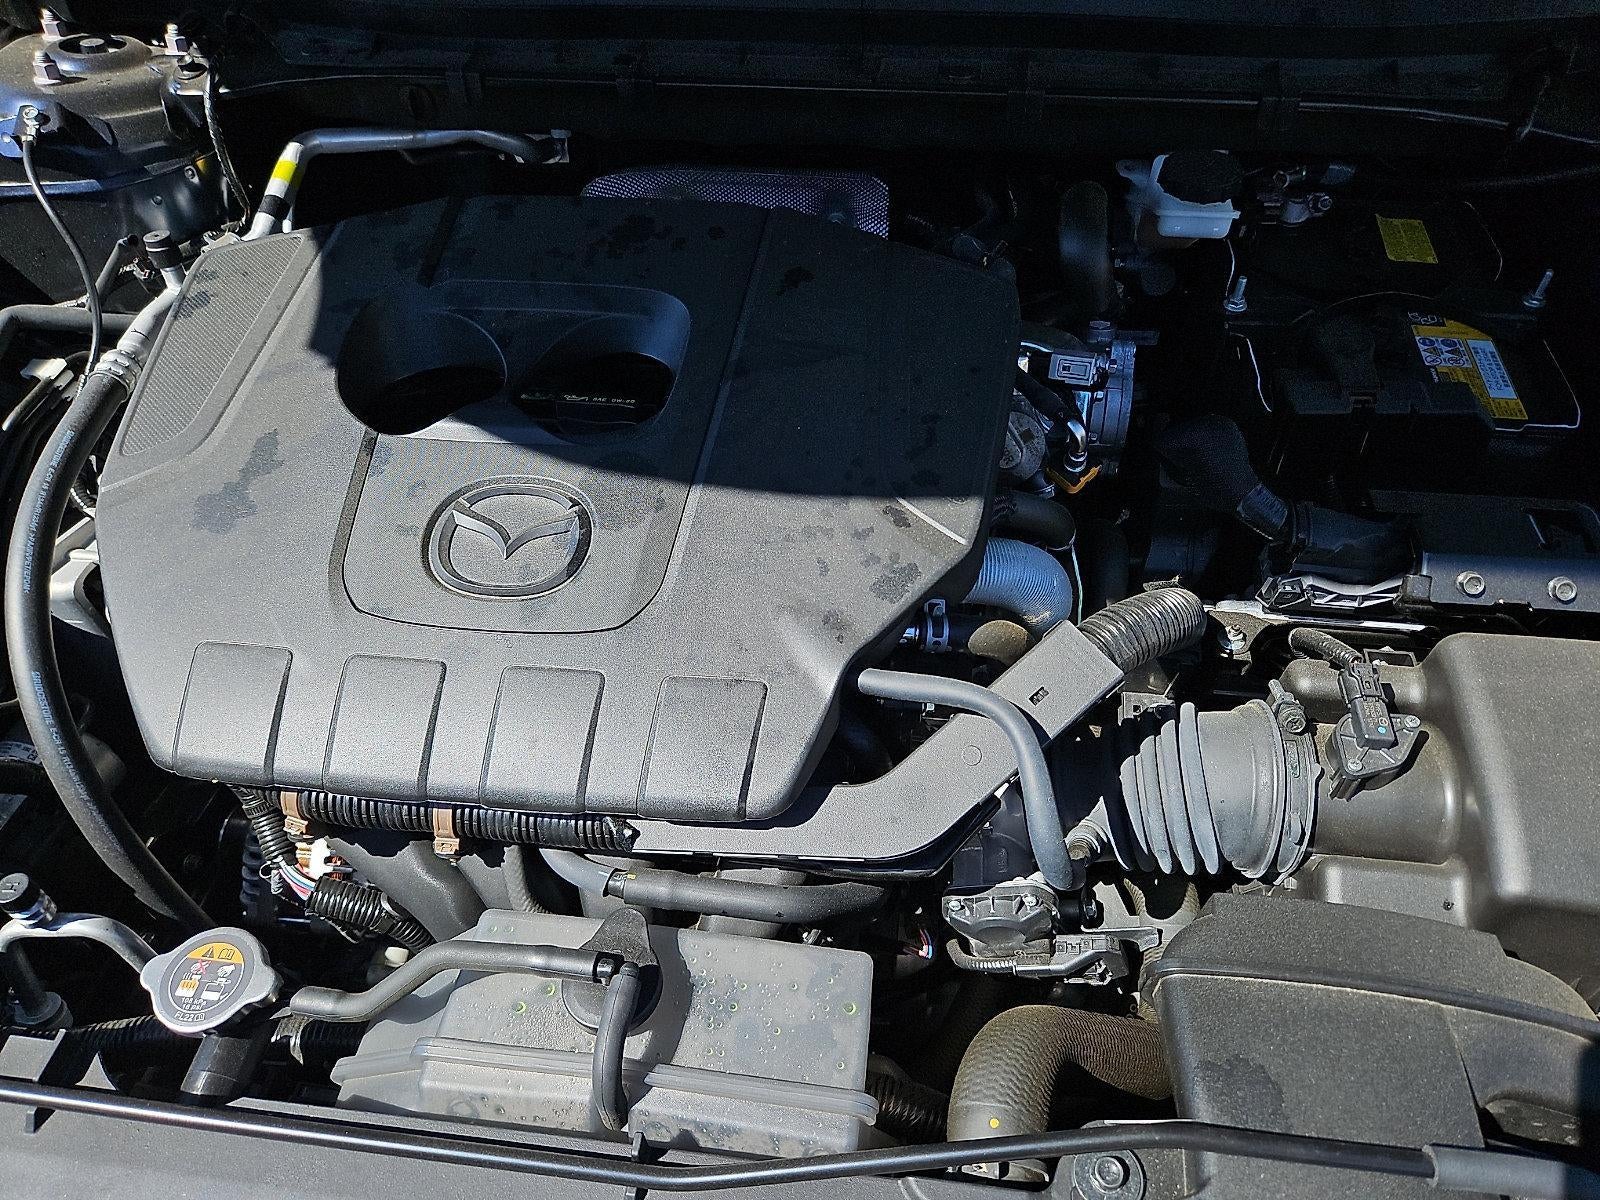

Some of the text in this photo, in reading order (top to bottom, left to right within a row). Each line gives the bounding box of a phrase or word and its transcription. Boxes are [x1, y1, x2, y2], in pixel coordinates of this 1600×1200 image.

[50, 429, 76, 468] BRIDGESTONE
[31, 671, 55, 726] BRIDGESTONE
[174, 1010, 194, 1021] FL22
